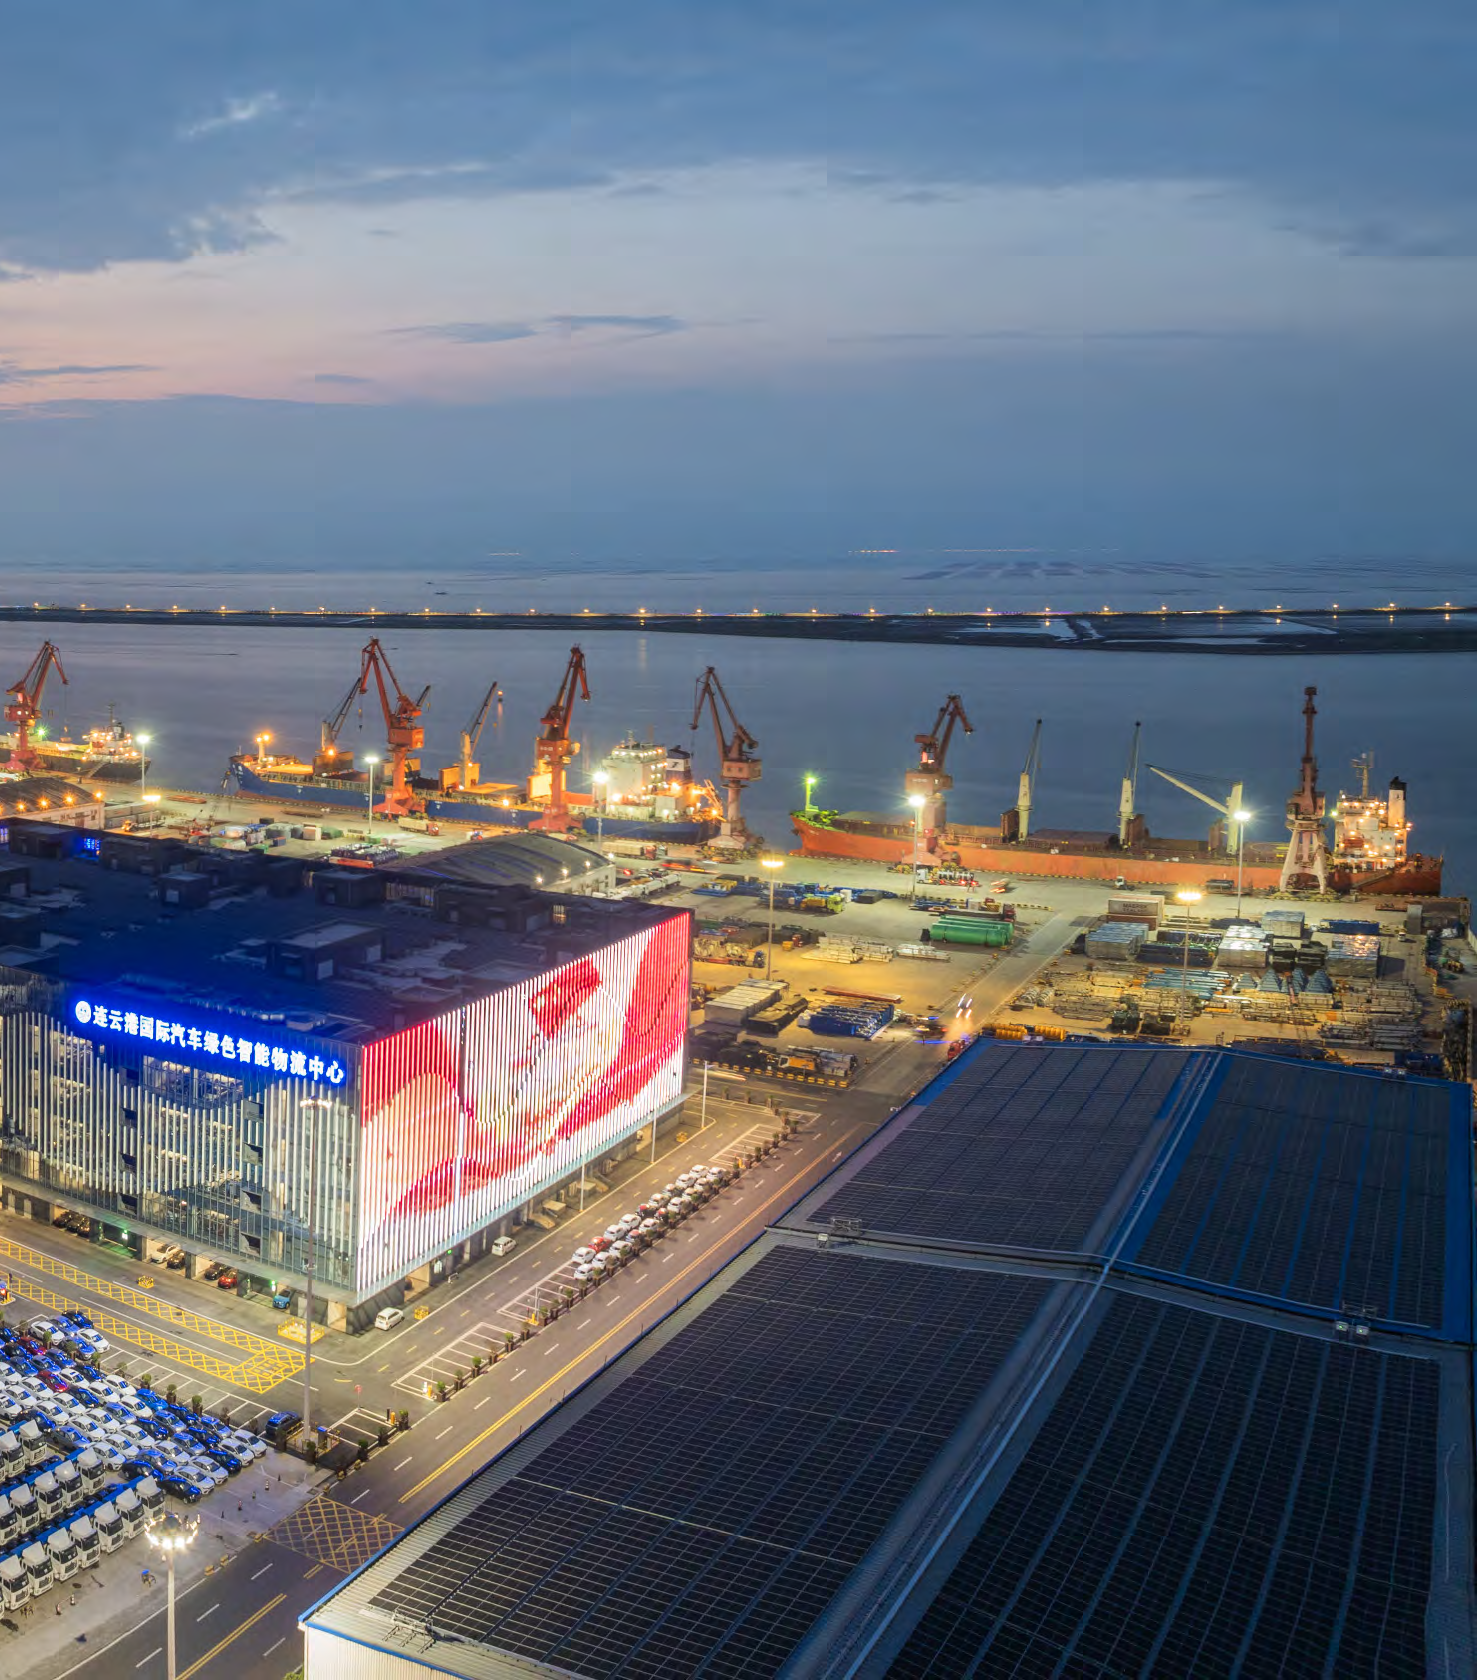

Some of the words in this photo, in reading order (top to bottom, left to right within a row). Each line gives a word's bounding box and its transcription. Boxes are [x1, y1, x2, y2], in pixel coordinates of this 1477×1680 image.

[93, 1005, 344, 1083] 连云港国际汽车绿色智能物流中心
